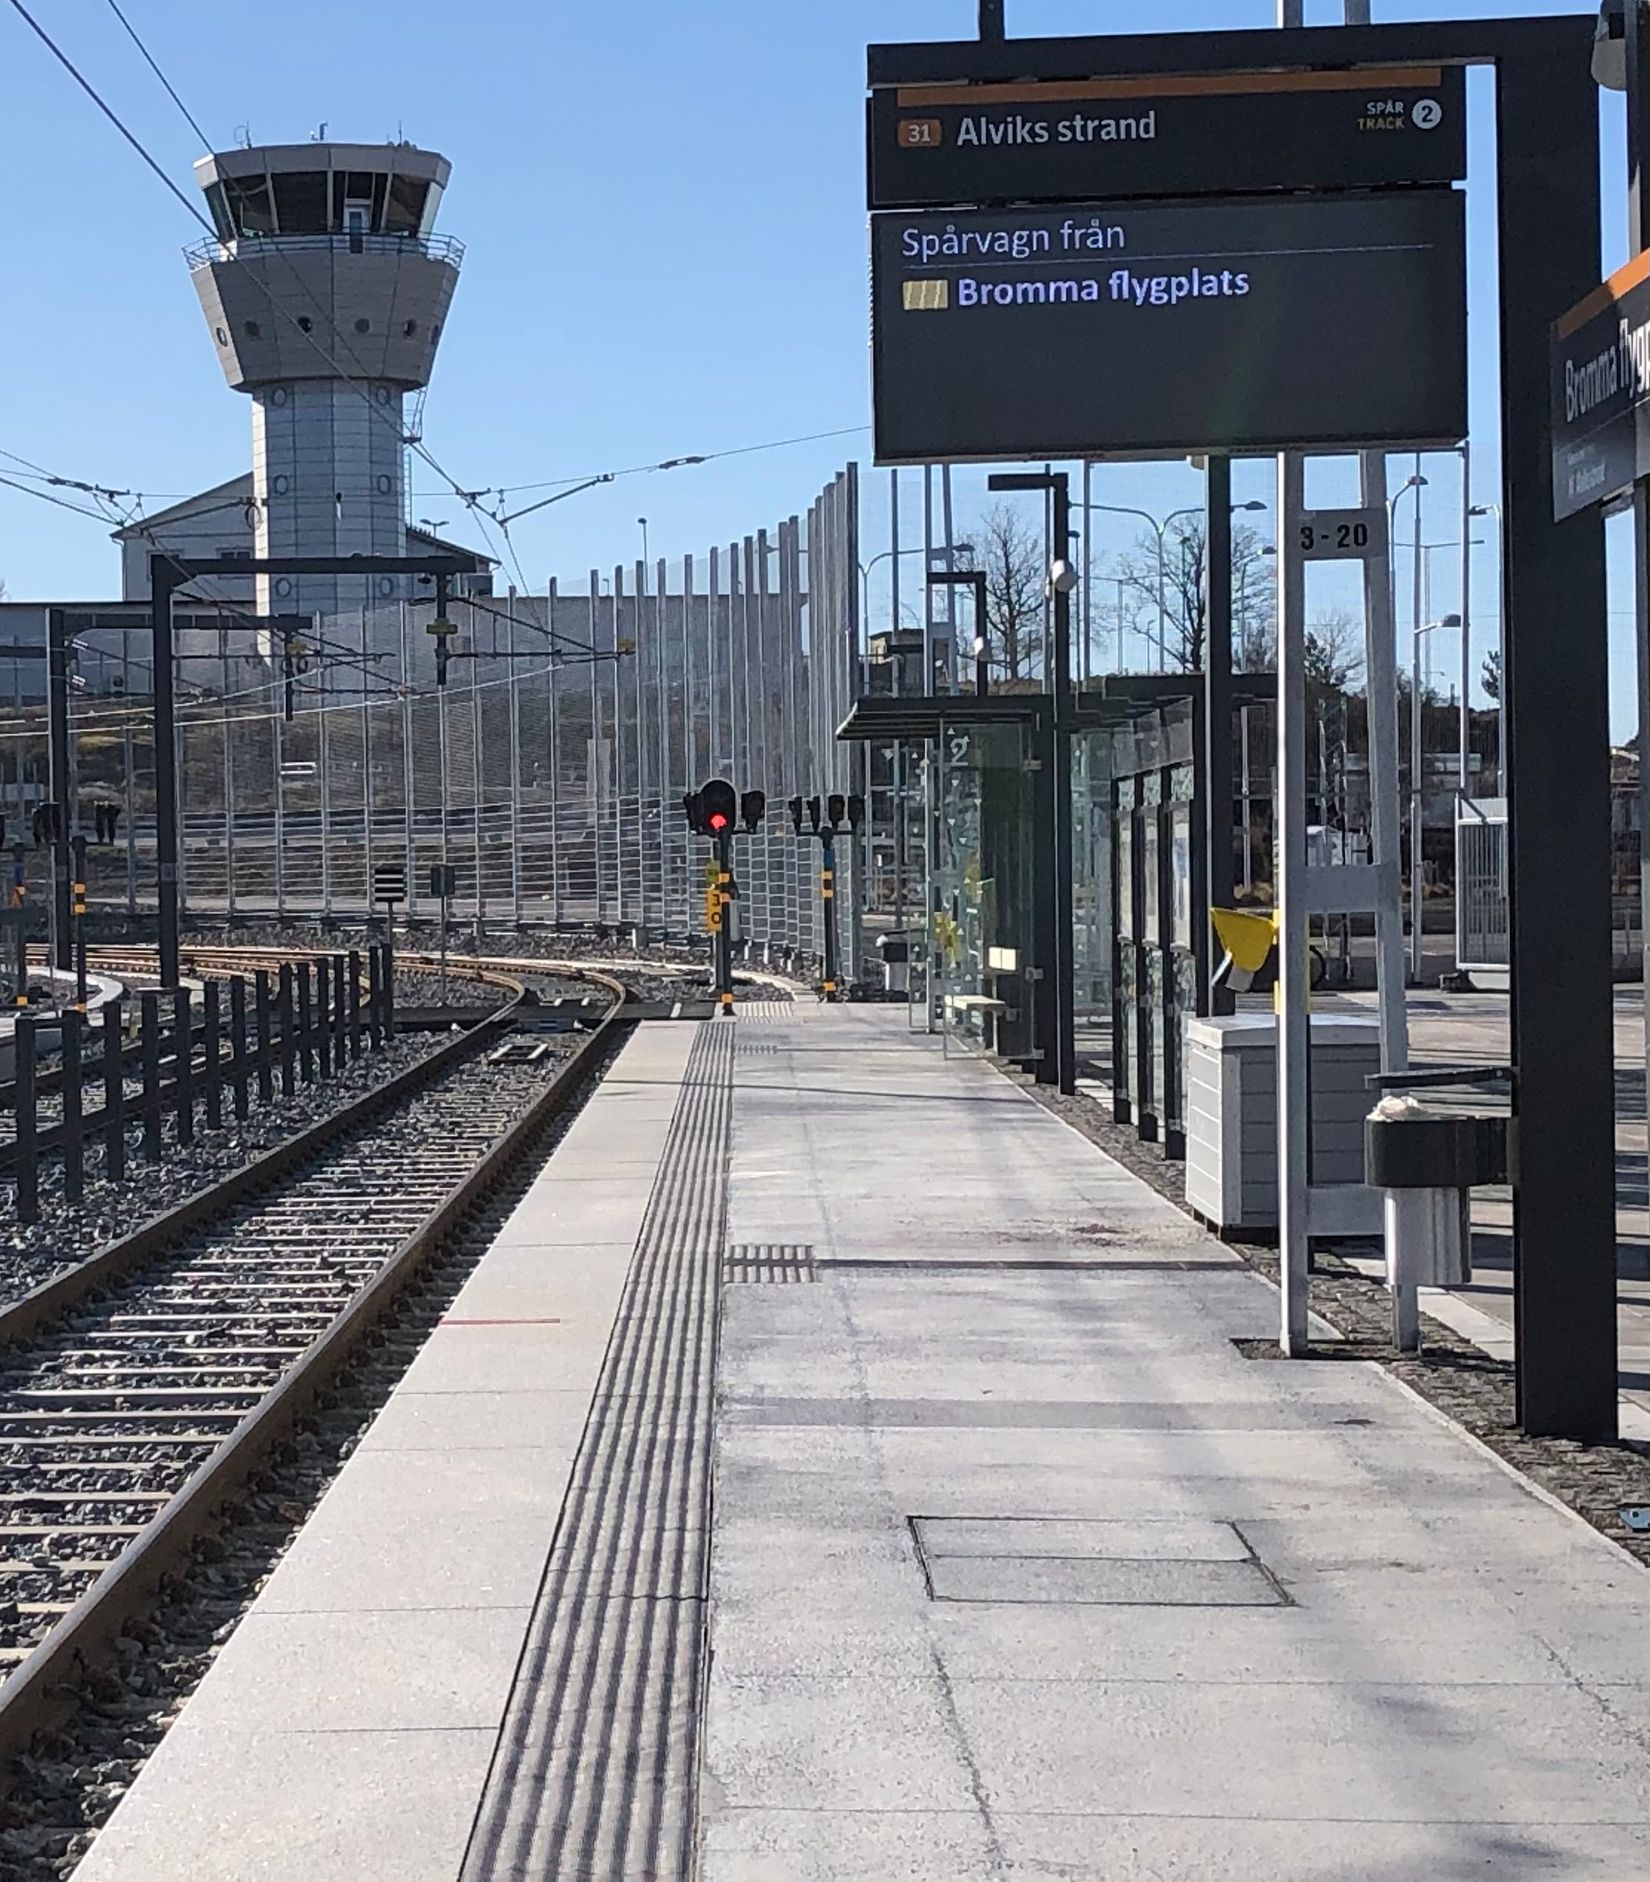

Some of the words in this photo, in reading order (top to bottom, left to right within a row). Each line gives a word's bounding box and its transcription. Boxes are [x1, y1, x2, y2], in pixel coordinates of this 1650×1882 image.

[1356, 116, 1405, 131] TRACK
[1366, 98, 1404, 115] SPÅR
[908, 124, 931, 143] 31
[956, 115, 1049, 146] Alviks
[1057, 110, 1156, 143] strand
[902, 224, 1050, 262] Spårvagn
[1059, 218, 1125, 250] från
[957, 278, 1099, 307] Bromma
[1108, 267, 1250, 306] flygplats
[1565, 344, 1618, 424] Bromma
